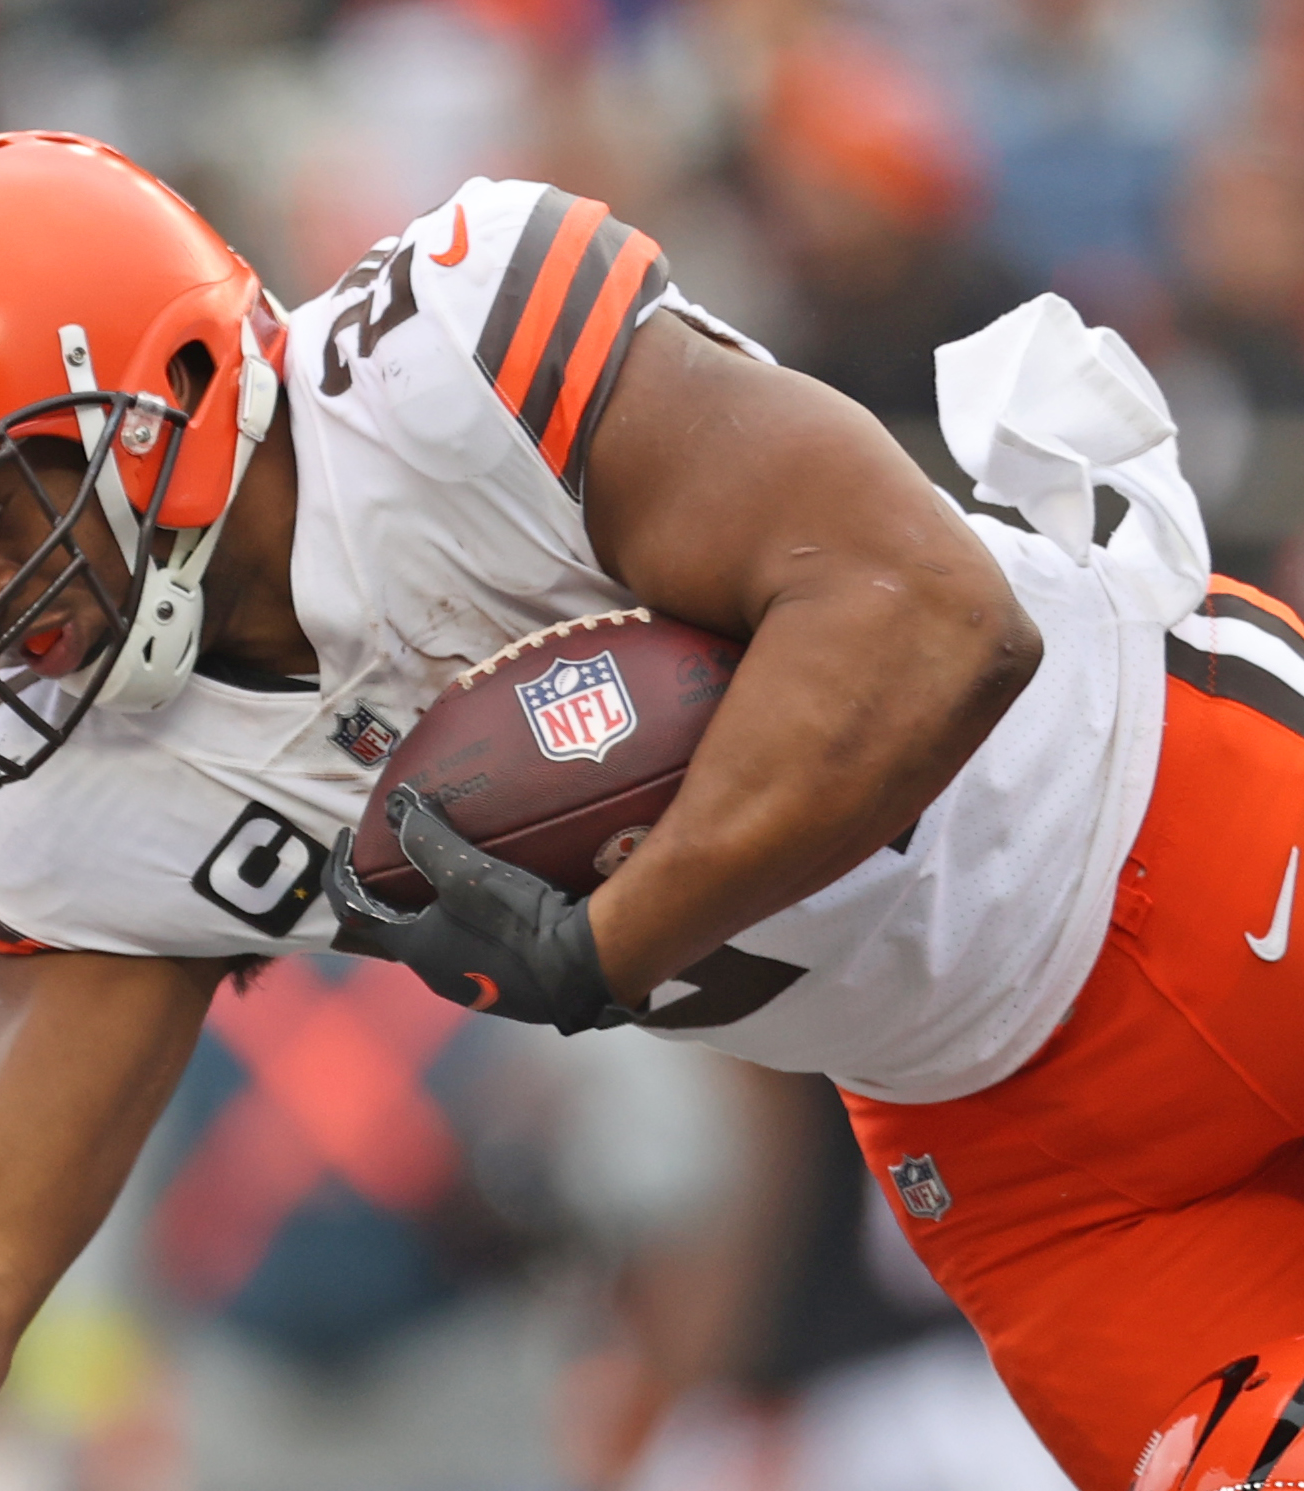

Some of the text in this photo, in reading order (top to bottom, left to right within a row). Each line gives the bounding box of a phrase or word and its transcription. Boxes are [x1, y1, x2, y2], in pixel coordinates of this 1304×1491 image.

[540, 689, 624, 748] NFL
[350, 725, 392, 763] NFL
[208, 817, 311, 916] C
[904, 1181, 943, 1210] NFL
